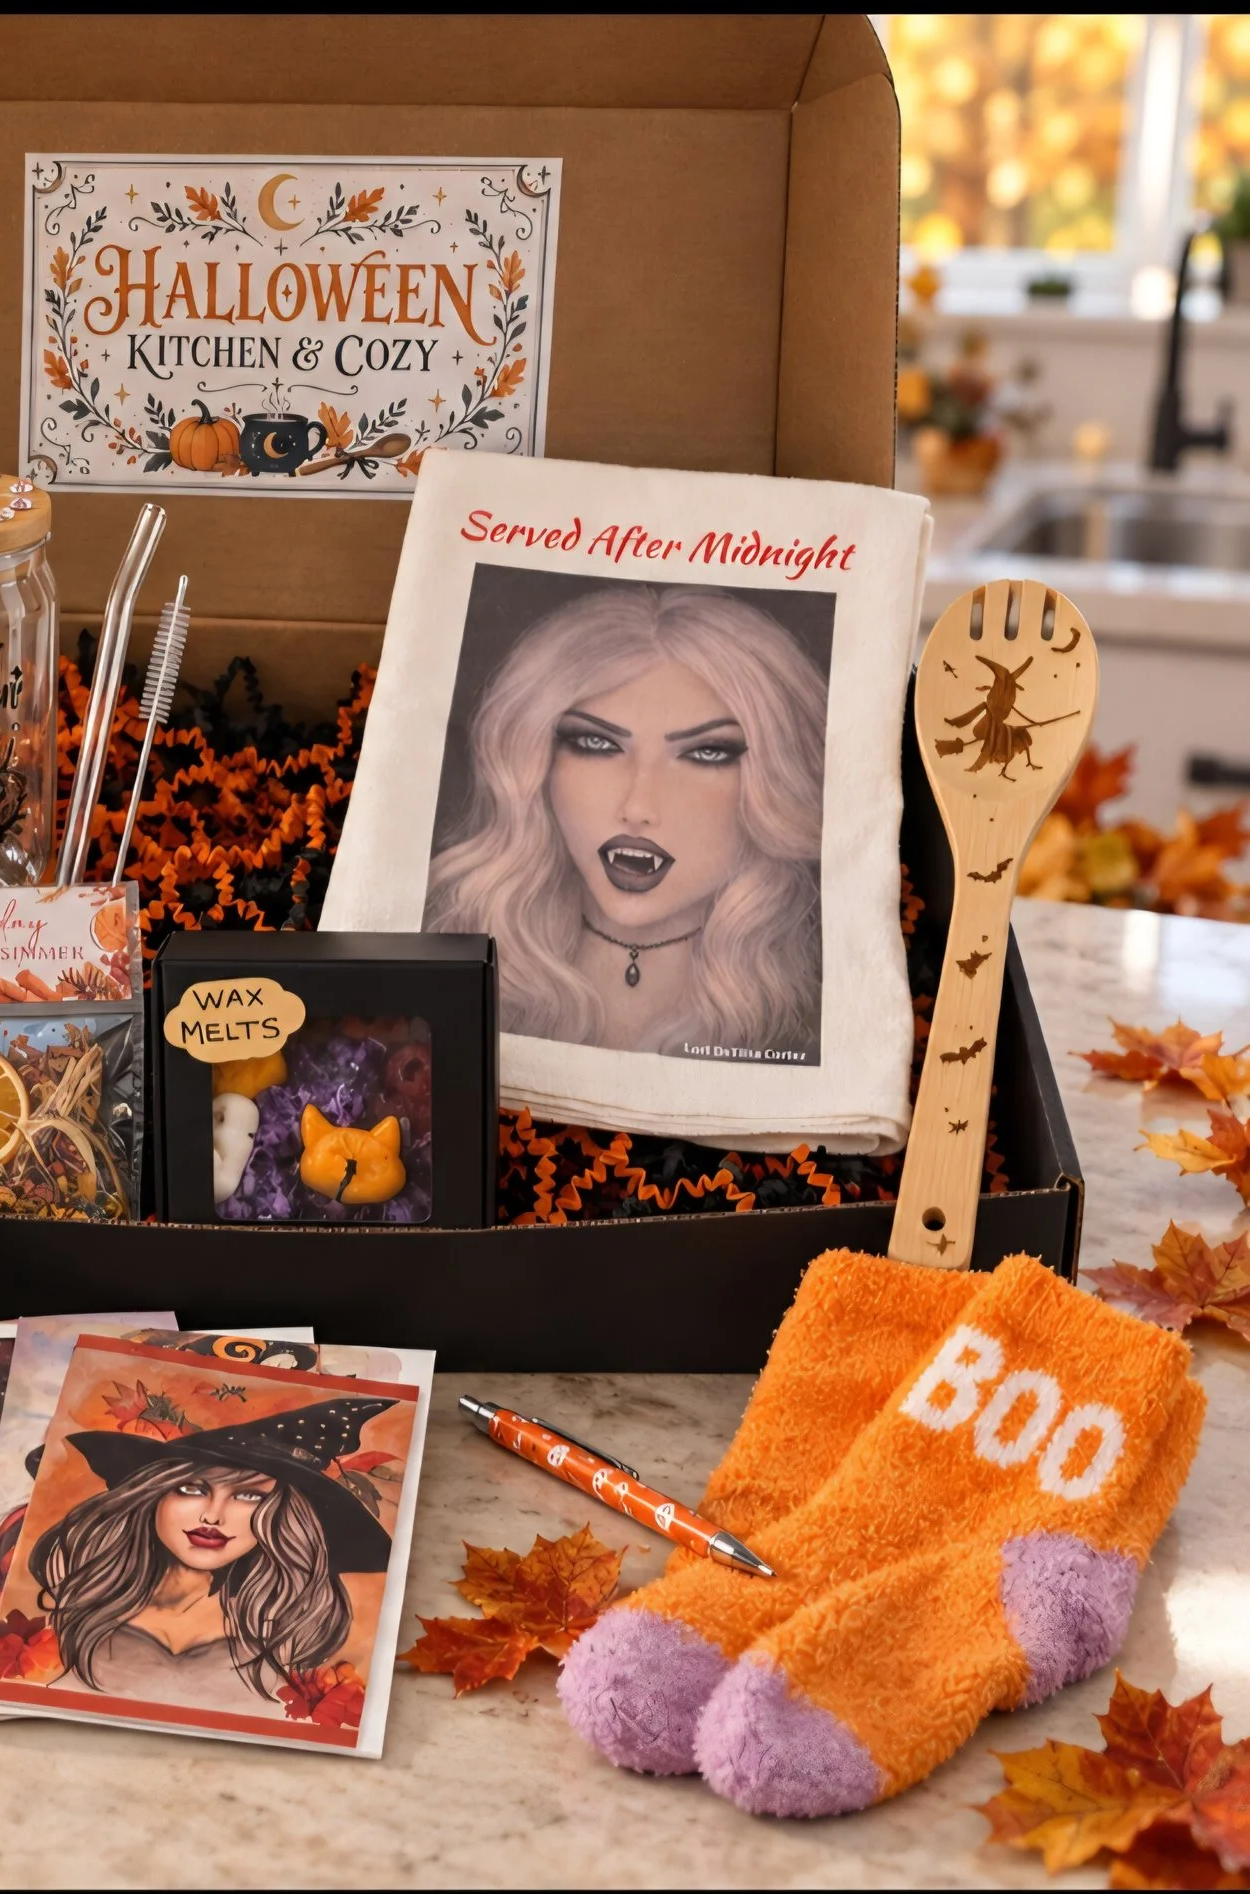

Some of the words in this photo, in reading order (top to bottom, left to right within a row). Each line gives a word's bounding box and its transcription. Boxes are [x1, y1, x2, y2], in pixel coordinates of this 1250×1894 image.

[83, 243, 497, 347] HALLOWEEN
[127, 334, 282, 380] KITCHEN
[291, 336, 325, 372] &
[334, 334, 439, 377] COZY
[461, 509, 582, 552] Served
[588, 525, 681, 564] After
[689, 530, 856, 581] Midnight
[192, 987, 264, 1011] WAX
[181, 1017, 280, 1045] MELTS
[901, 1324, 1127, 1500] BOO
